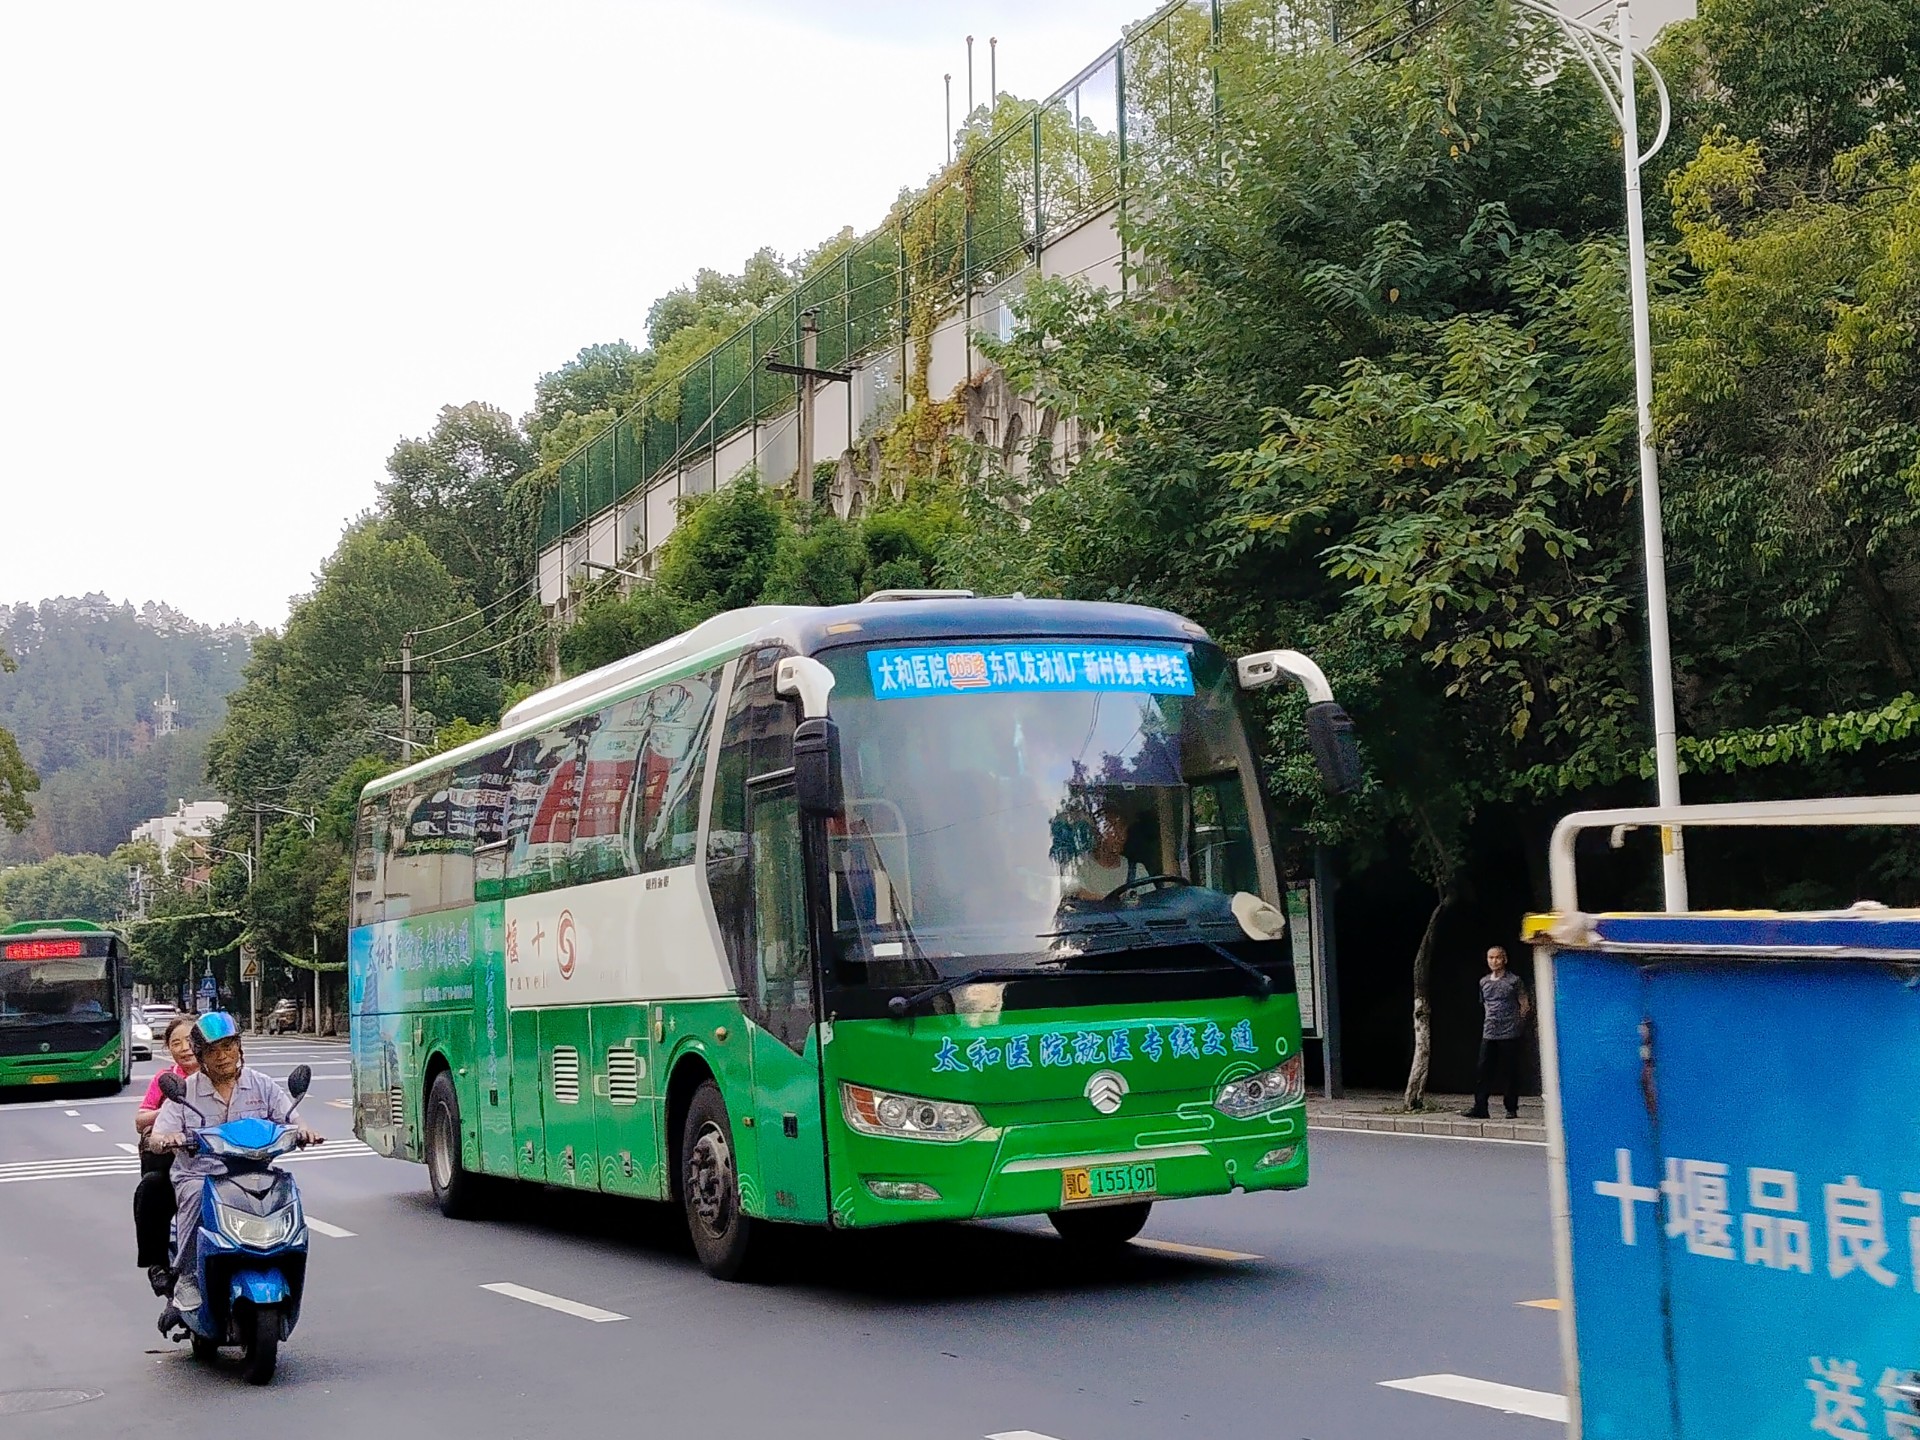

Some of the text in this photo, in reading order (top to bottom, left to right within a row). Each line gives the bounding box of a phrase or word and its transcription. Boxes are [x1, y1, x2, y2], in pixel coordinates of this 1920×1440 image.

[878, 653, 948, 691] 太和医院
[931, 1018, 1259, 1074] 太和医院就医专线交通
[1593, 1147, 1920, 1293] 十堰品良
